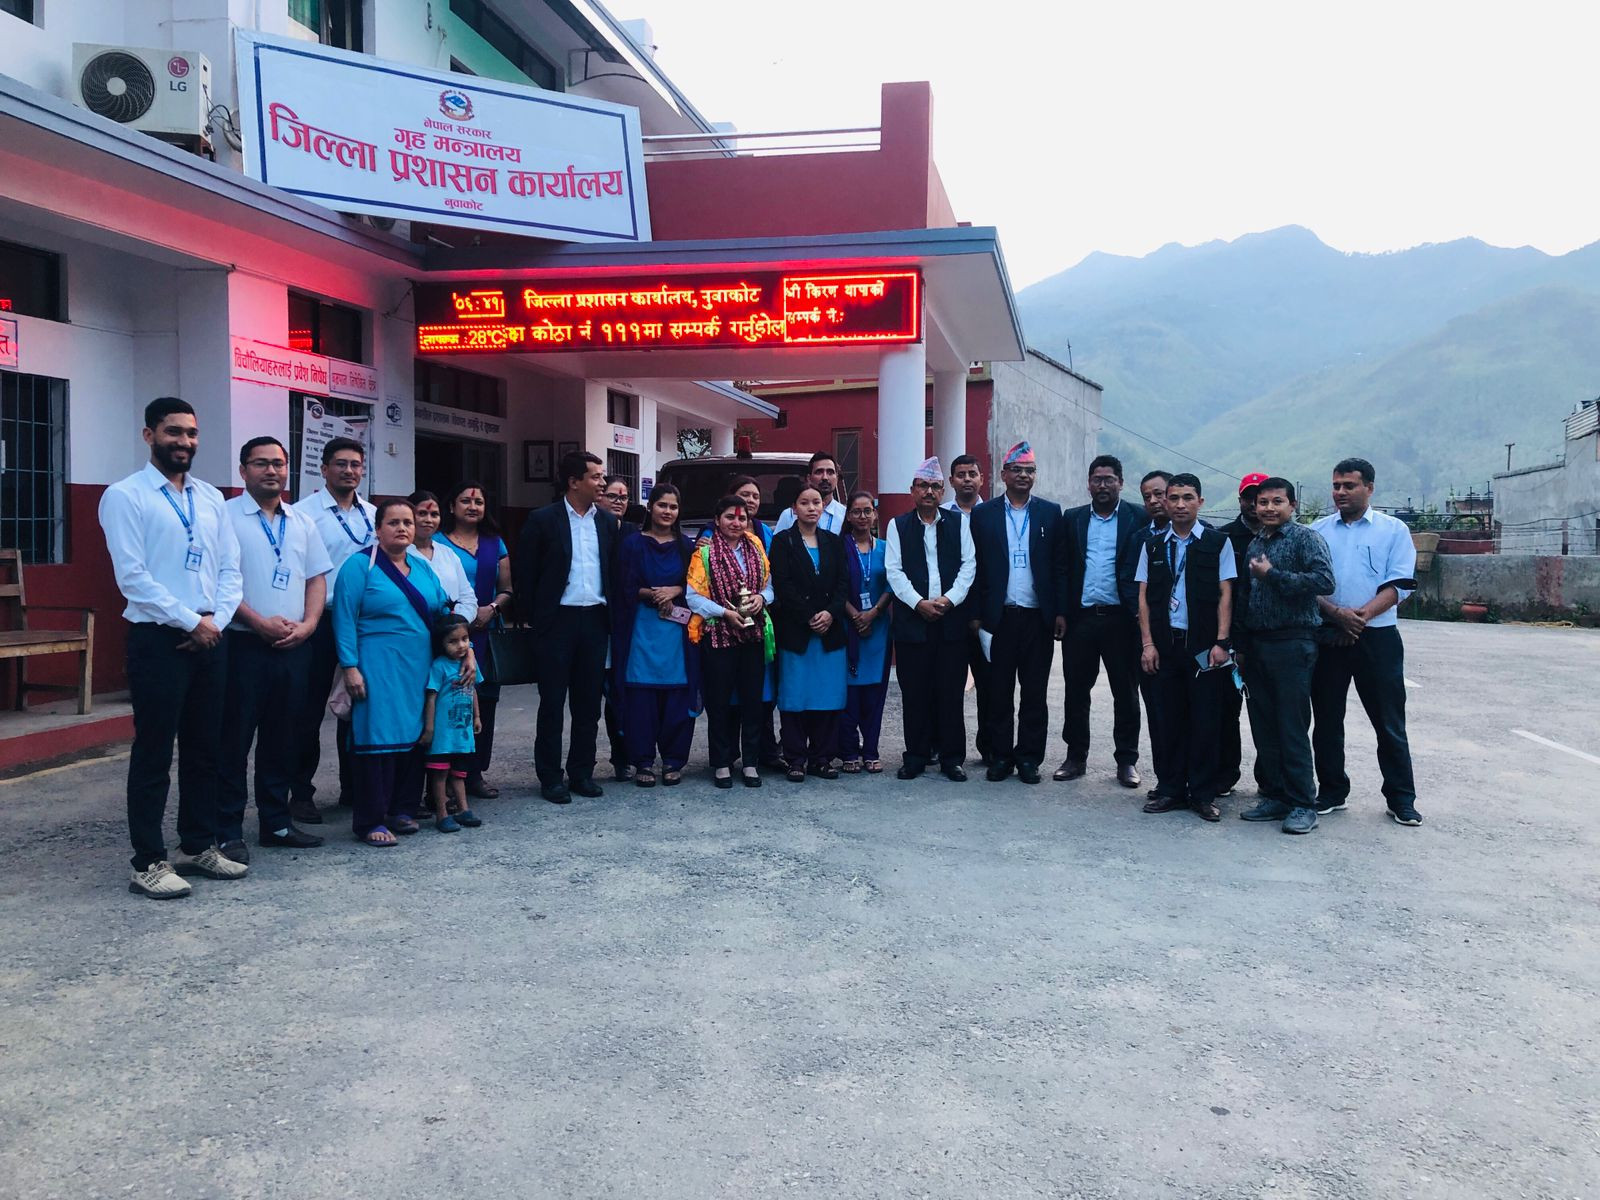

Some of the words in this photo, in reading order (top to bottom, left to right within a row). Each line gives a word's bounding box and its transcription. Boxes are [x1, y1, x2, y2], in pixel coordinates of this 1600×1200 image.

[169, 81, 187, 92] LG
[424, 117, 453, 132] नेपाल
[457, 126, 493, 139] सरकार
[269, 102, 378, 172] जिल्ला
[388, 149, 498, 194] प्रशासन
[507, 165, 623, 199] कार्यालय
[394, 128, 427, 150] गृह
[433, 135, 522, 163] मन्त्रालय
[444, 198, 484, 211] नुवाकोट
[524, 289, 573, 308] जिल्ला
[575, 293, 629, 308] प्रशासन
[700, 282, 762, 310] नुवाकोट
[805, 282, 839, 298] किरण
[531, 318, 573, 342] कोठा
[669, 315, 722, 339] सम्पर्क
